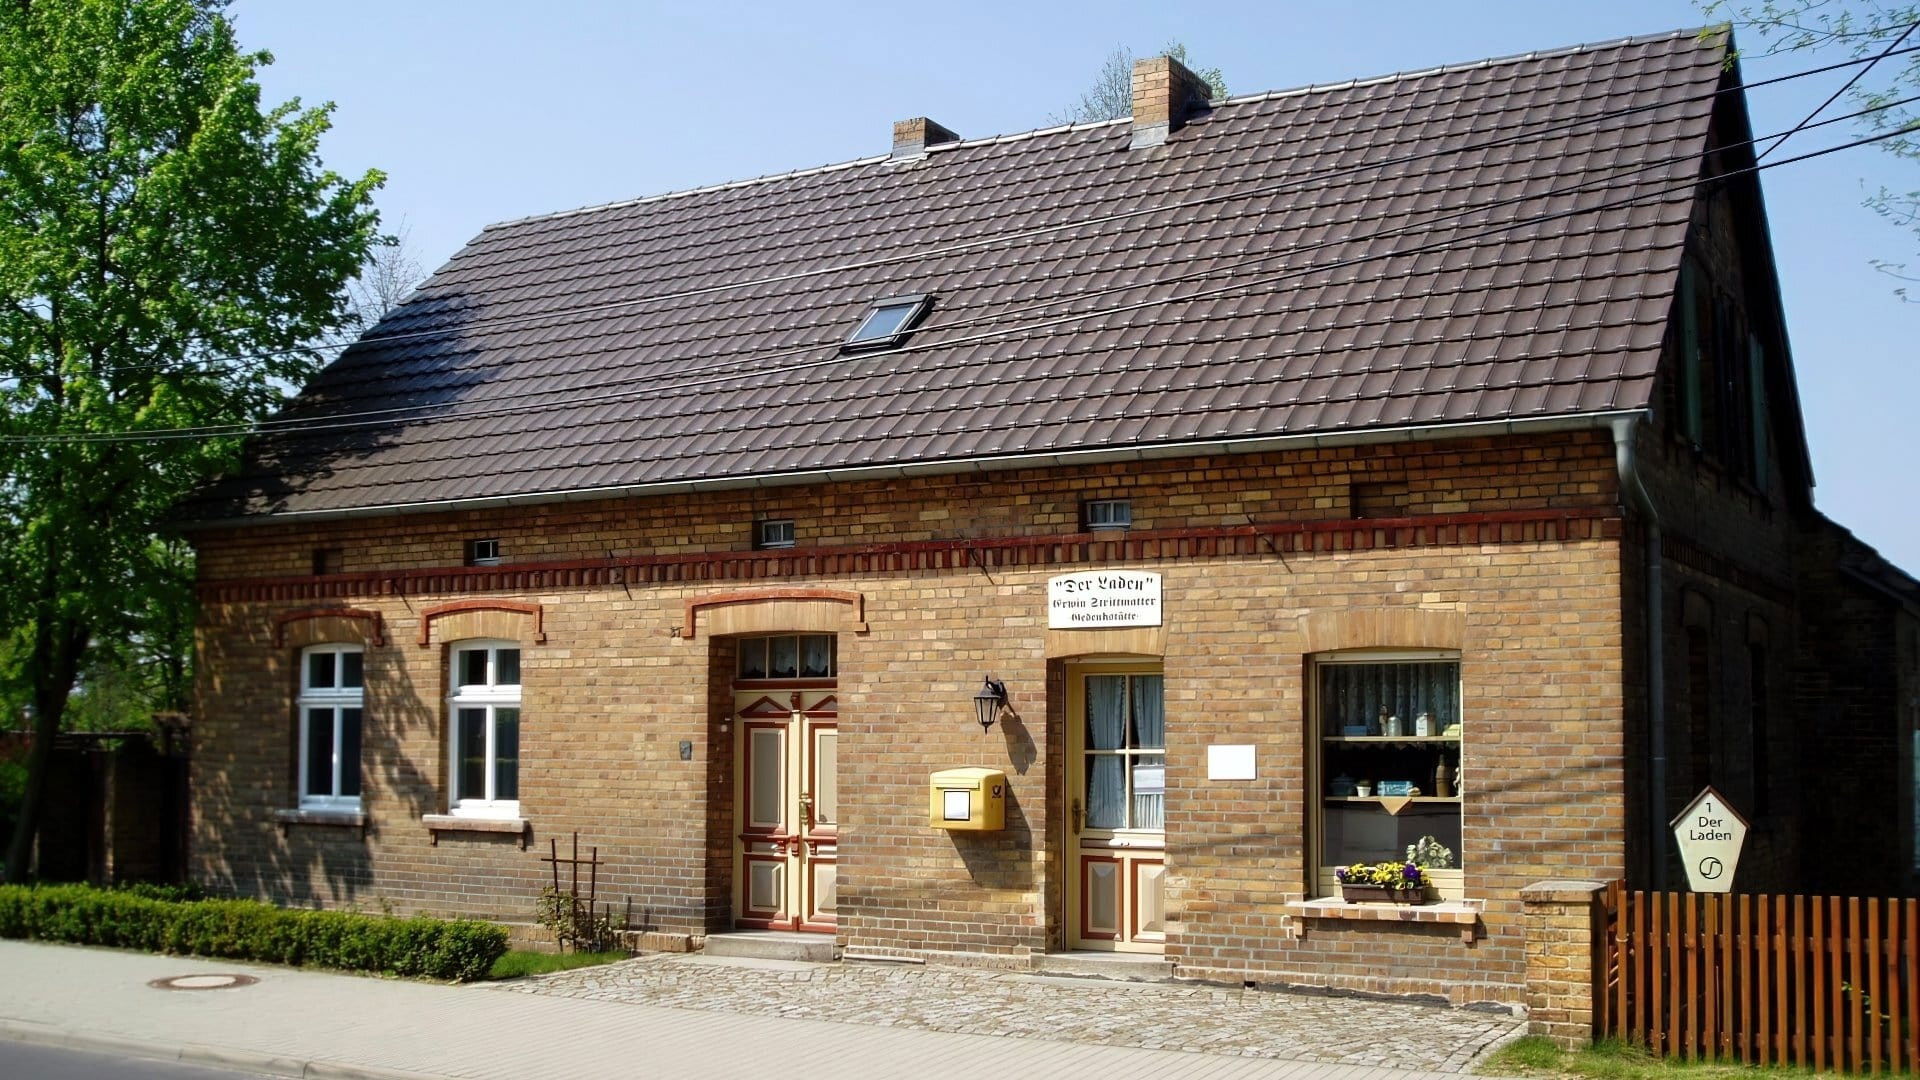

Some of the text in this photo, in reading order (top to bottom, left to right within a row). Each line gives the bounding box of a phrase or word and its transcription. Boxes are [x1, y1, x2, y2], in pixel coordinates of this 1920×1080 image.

[1053, 597, 1156, 609] Erwin Strittmatter
[1705, 802, 1712, 813] 1
[1698, 816, 1723, 828] Der
[1690, 829, 1732, 841] Laden
